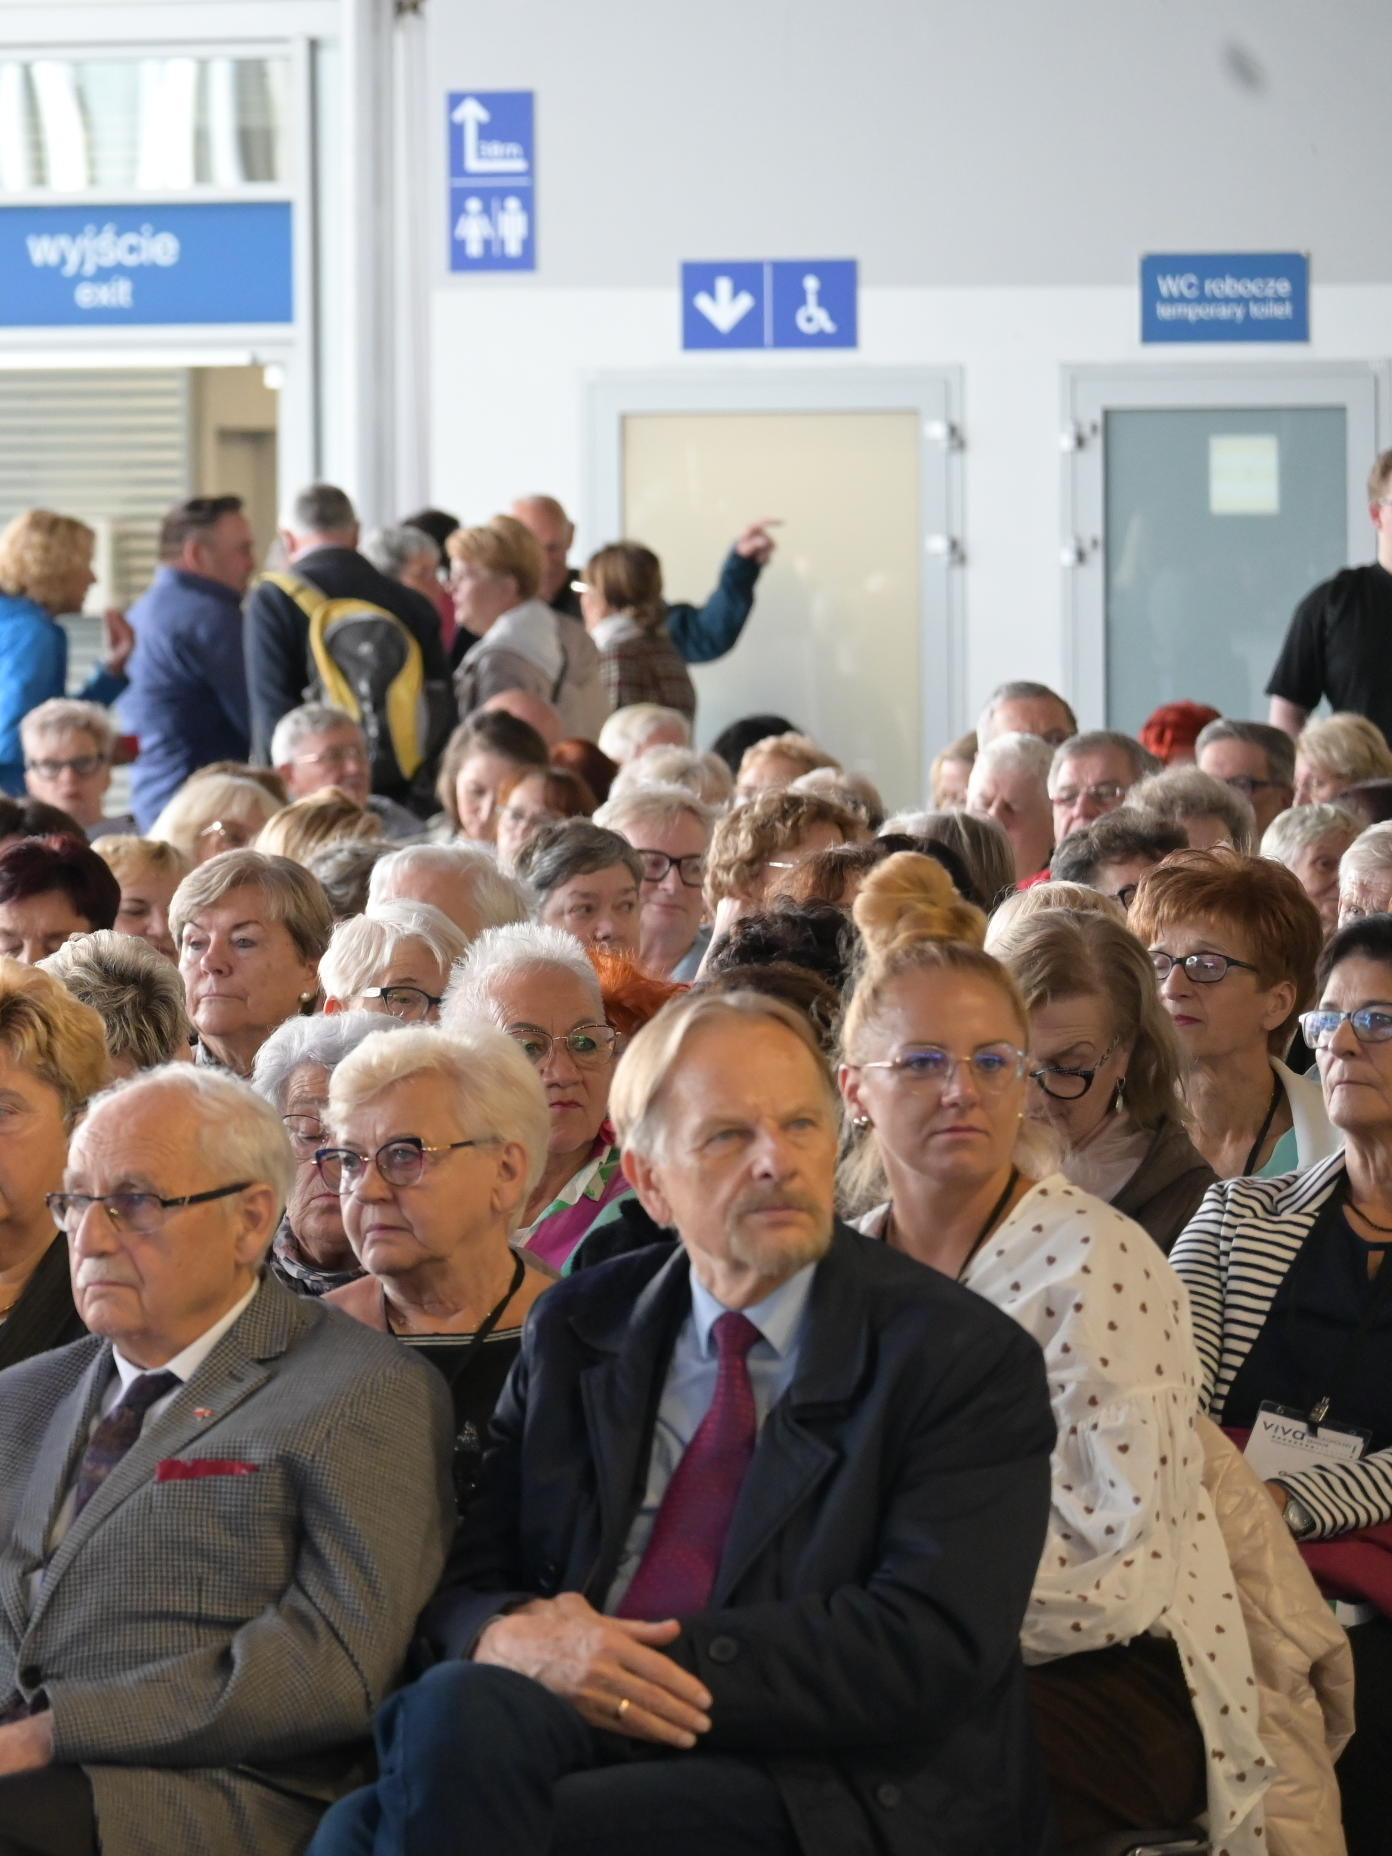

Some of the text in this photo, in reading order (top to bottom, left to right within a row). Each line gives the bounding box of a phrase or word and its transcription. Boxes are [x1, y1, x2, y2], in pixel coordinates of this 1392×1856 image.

[27, 223, 179, 276] wyjście
[74, 276, 133, 308] exit
[1156, 273, 1292, 298] WC robocze
[1155, 300, 1293, 323] temporary toilet
[1263, 1420, 1306, 1441] viva
